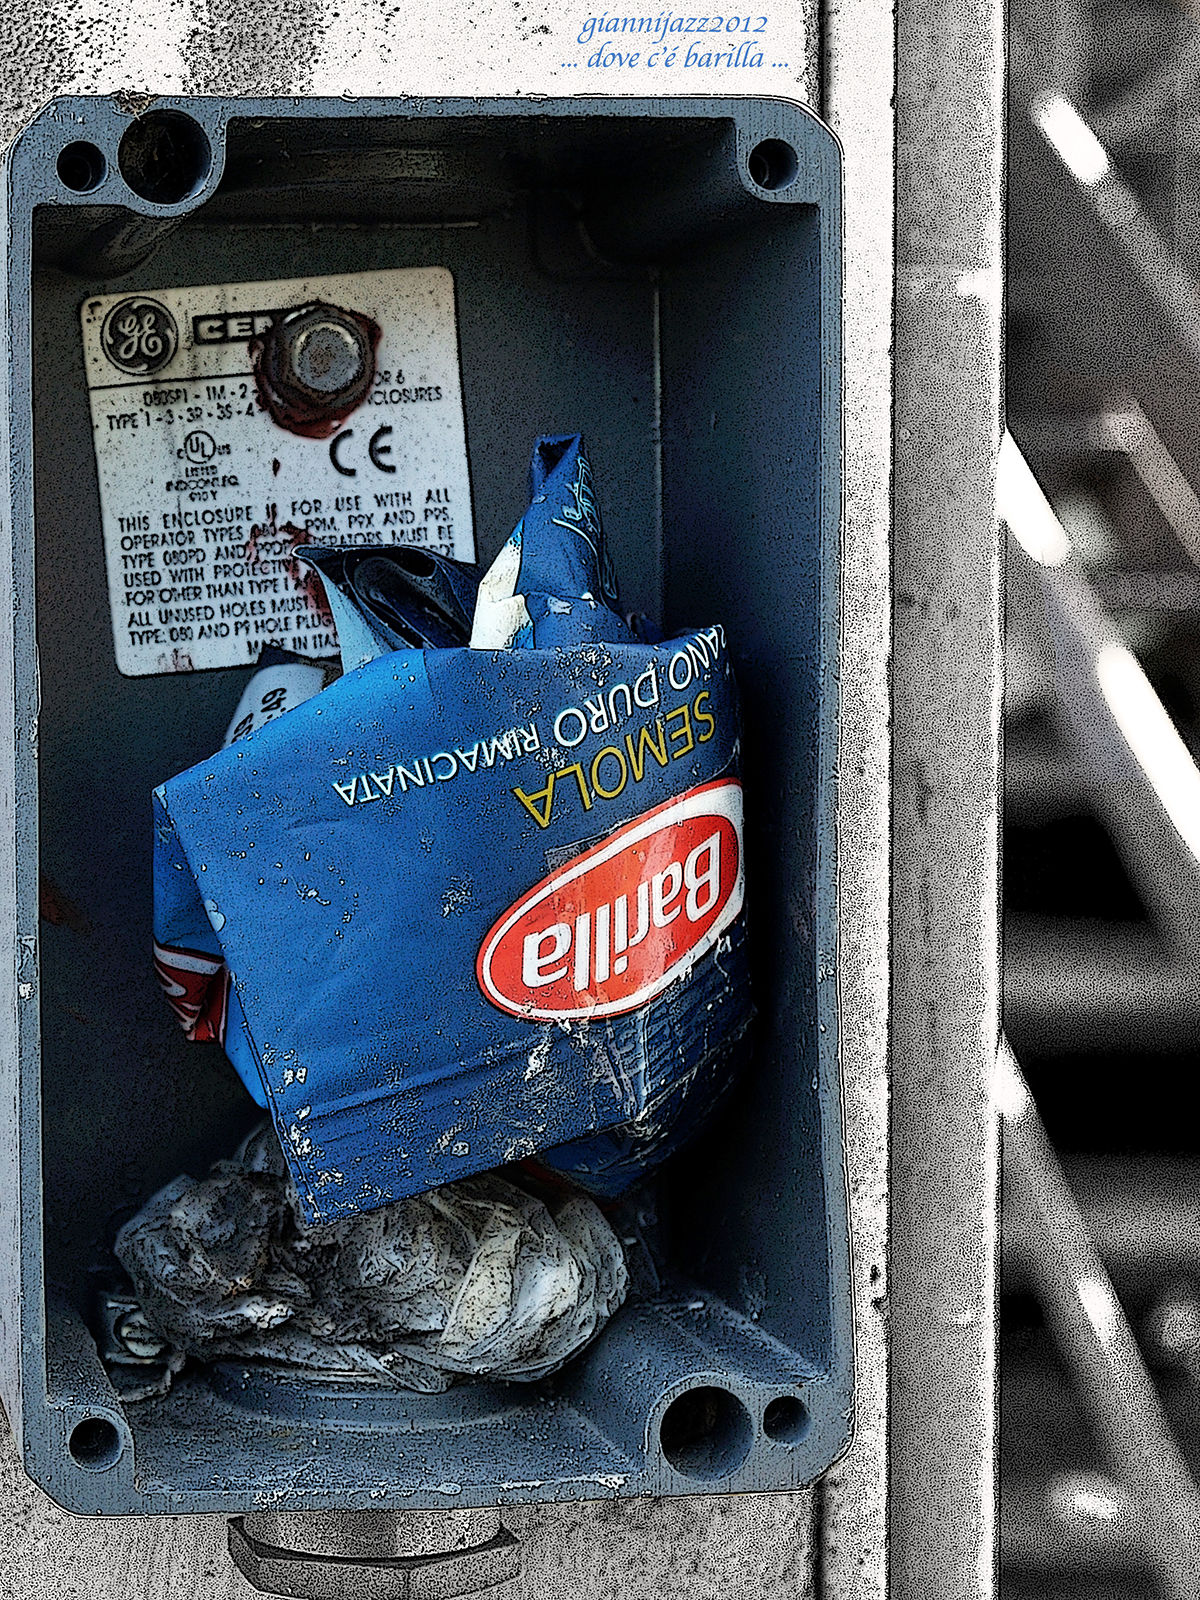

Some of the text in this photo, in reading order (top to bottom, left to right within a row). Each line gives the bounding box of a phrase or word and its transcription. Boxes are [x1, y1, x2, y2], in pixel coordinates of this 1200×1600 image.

[106, 411, 139, 430] TYPE
[368, 386, 442, 405] CLOSURES
[239, 383, 248, 399] 2
[330, 425, 396, 477] CE
[118, 515, 150, 533] THIS
[162, 505, 253, 529] ENCLOSURE
[291, 499, 322, 516] FOR
[335, 495, 361, 511] USE
[374, 491, 412, 508] WITH
[425, 488, 451, 504] ALL
[120, 530, 195, 551] OPERATOR
[203, 525, 244, 543] TYPES
[382, 510, 415, 526] AND
[122, 552, 156, 569] TYPE
[306, 531, 383, 546] PERATORS
[391, 527, 428, 543] MUST
[124, 570, 162, 588] USED
[169, 567, 205, 584] WITH
[213, 558, 299, 580] PROTECTIV
[125, 590, 154, 607] FOR
[158, 586, 202, 603] OTHER
[205, 581, 244, 599] THAN
[248, 577, 280, 595] TYPE
[128, 612, 153, 628] ALL
[158, 605, 215, 625] UNUSED
[220, 600, 266, 618] HOLES
[271, 594, 309, 613] MUST
[198, 622, 230, 640] AND
[254, 616, 292, 634] HOLE
[292, 635, 308, 650] IN
[312, 631, 341, 650] ITAL
[553, 668, 662, 747] DURO
[332, 722, 541, 806] RIMACINATA
[513, 691, 716, 828] SEMOLA
[521, 831, 723, 992] Barilla
